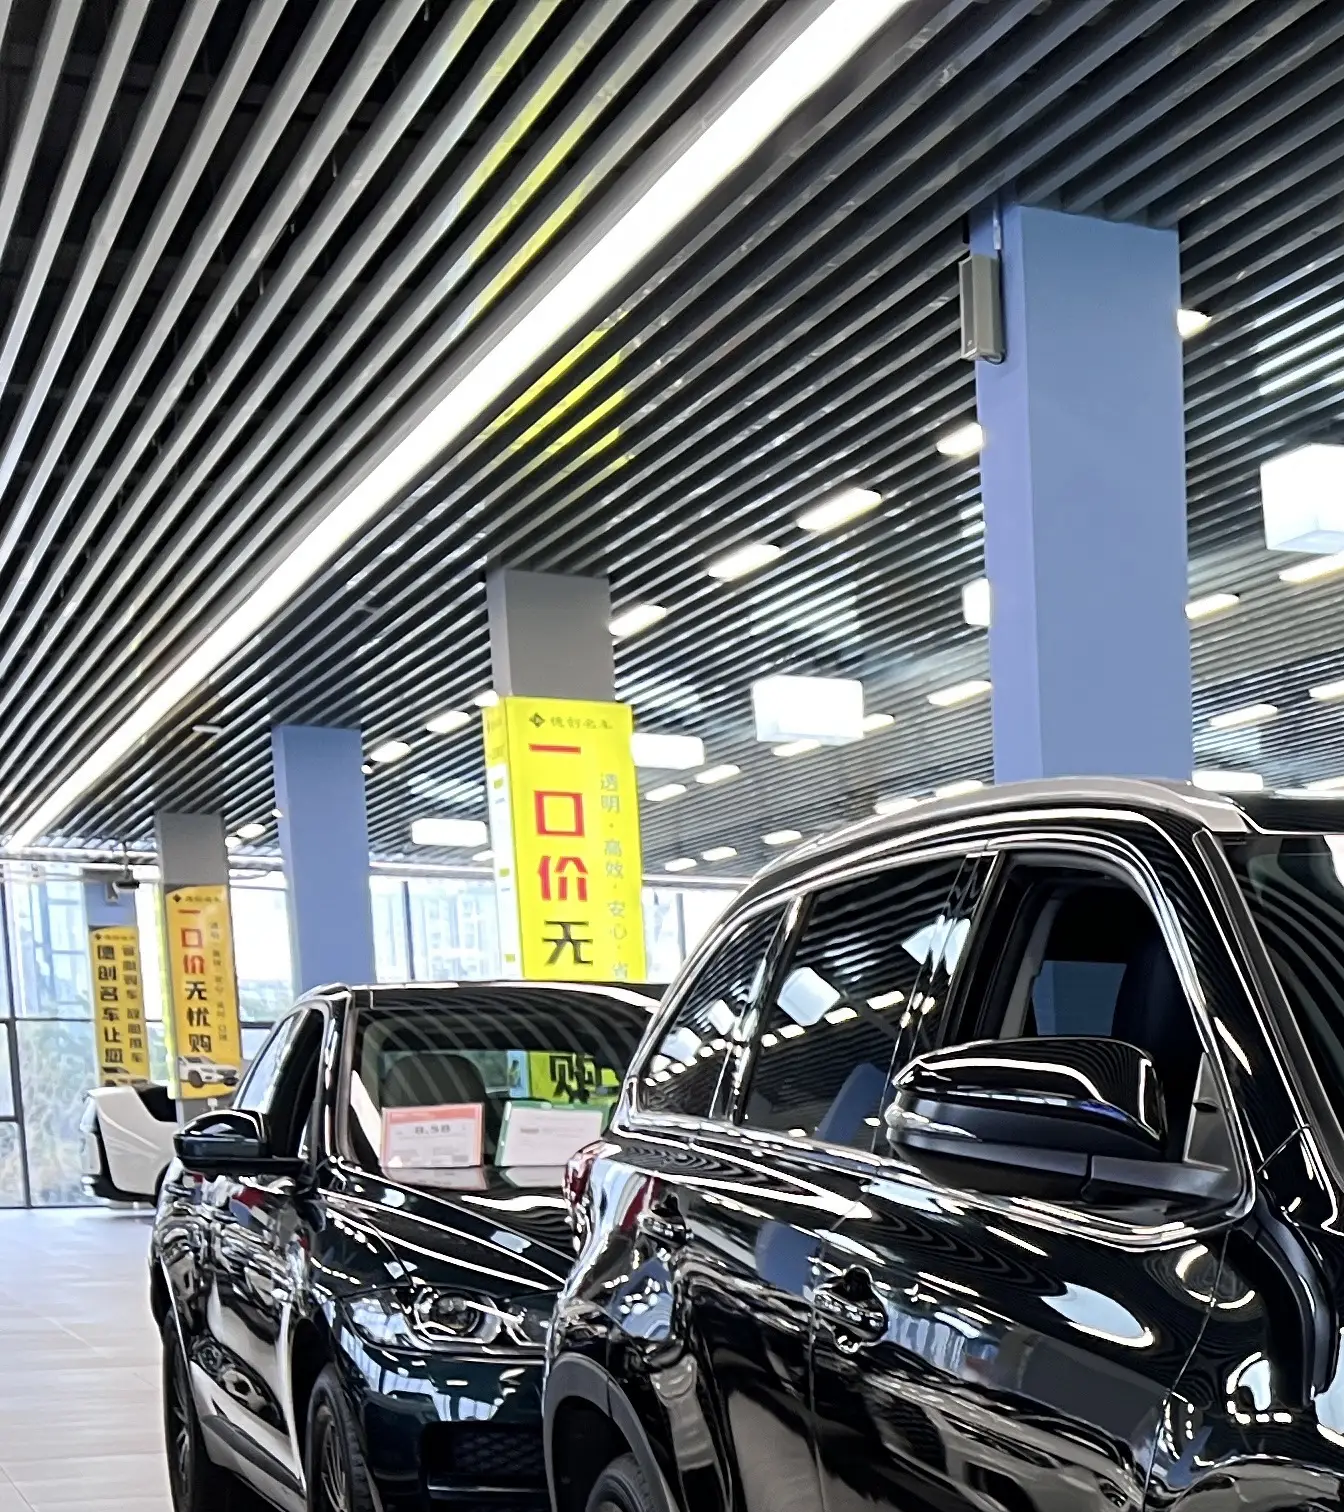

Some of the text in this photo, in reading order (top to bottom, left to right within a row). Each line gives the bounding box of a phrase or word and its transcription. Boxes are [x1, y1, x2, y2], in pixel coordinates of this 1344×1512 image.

[528, 743, 594, 967] 一口价无
[178, 908, 213, 1053] 一口价无忧购
